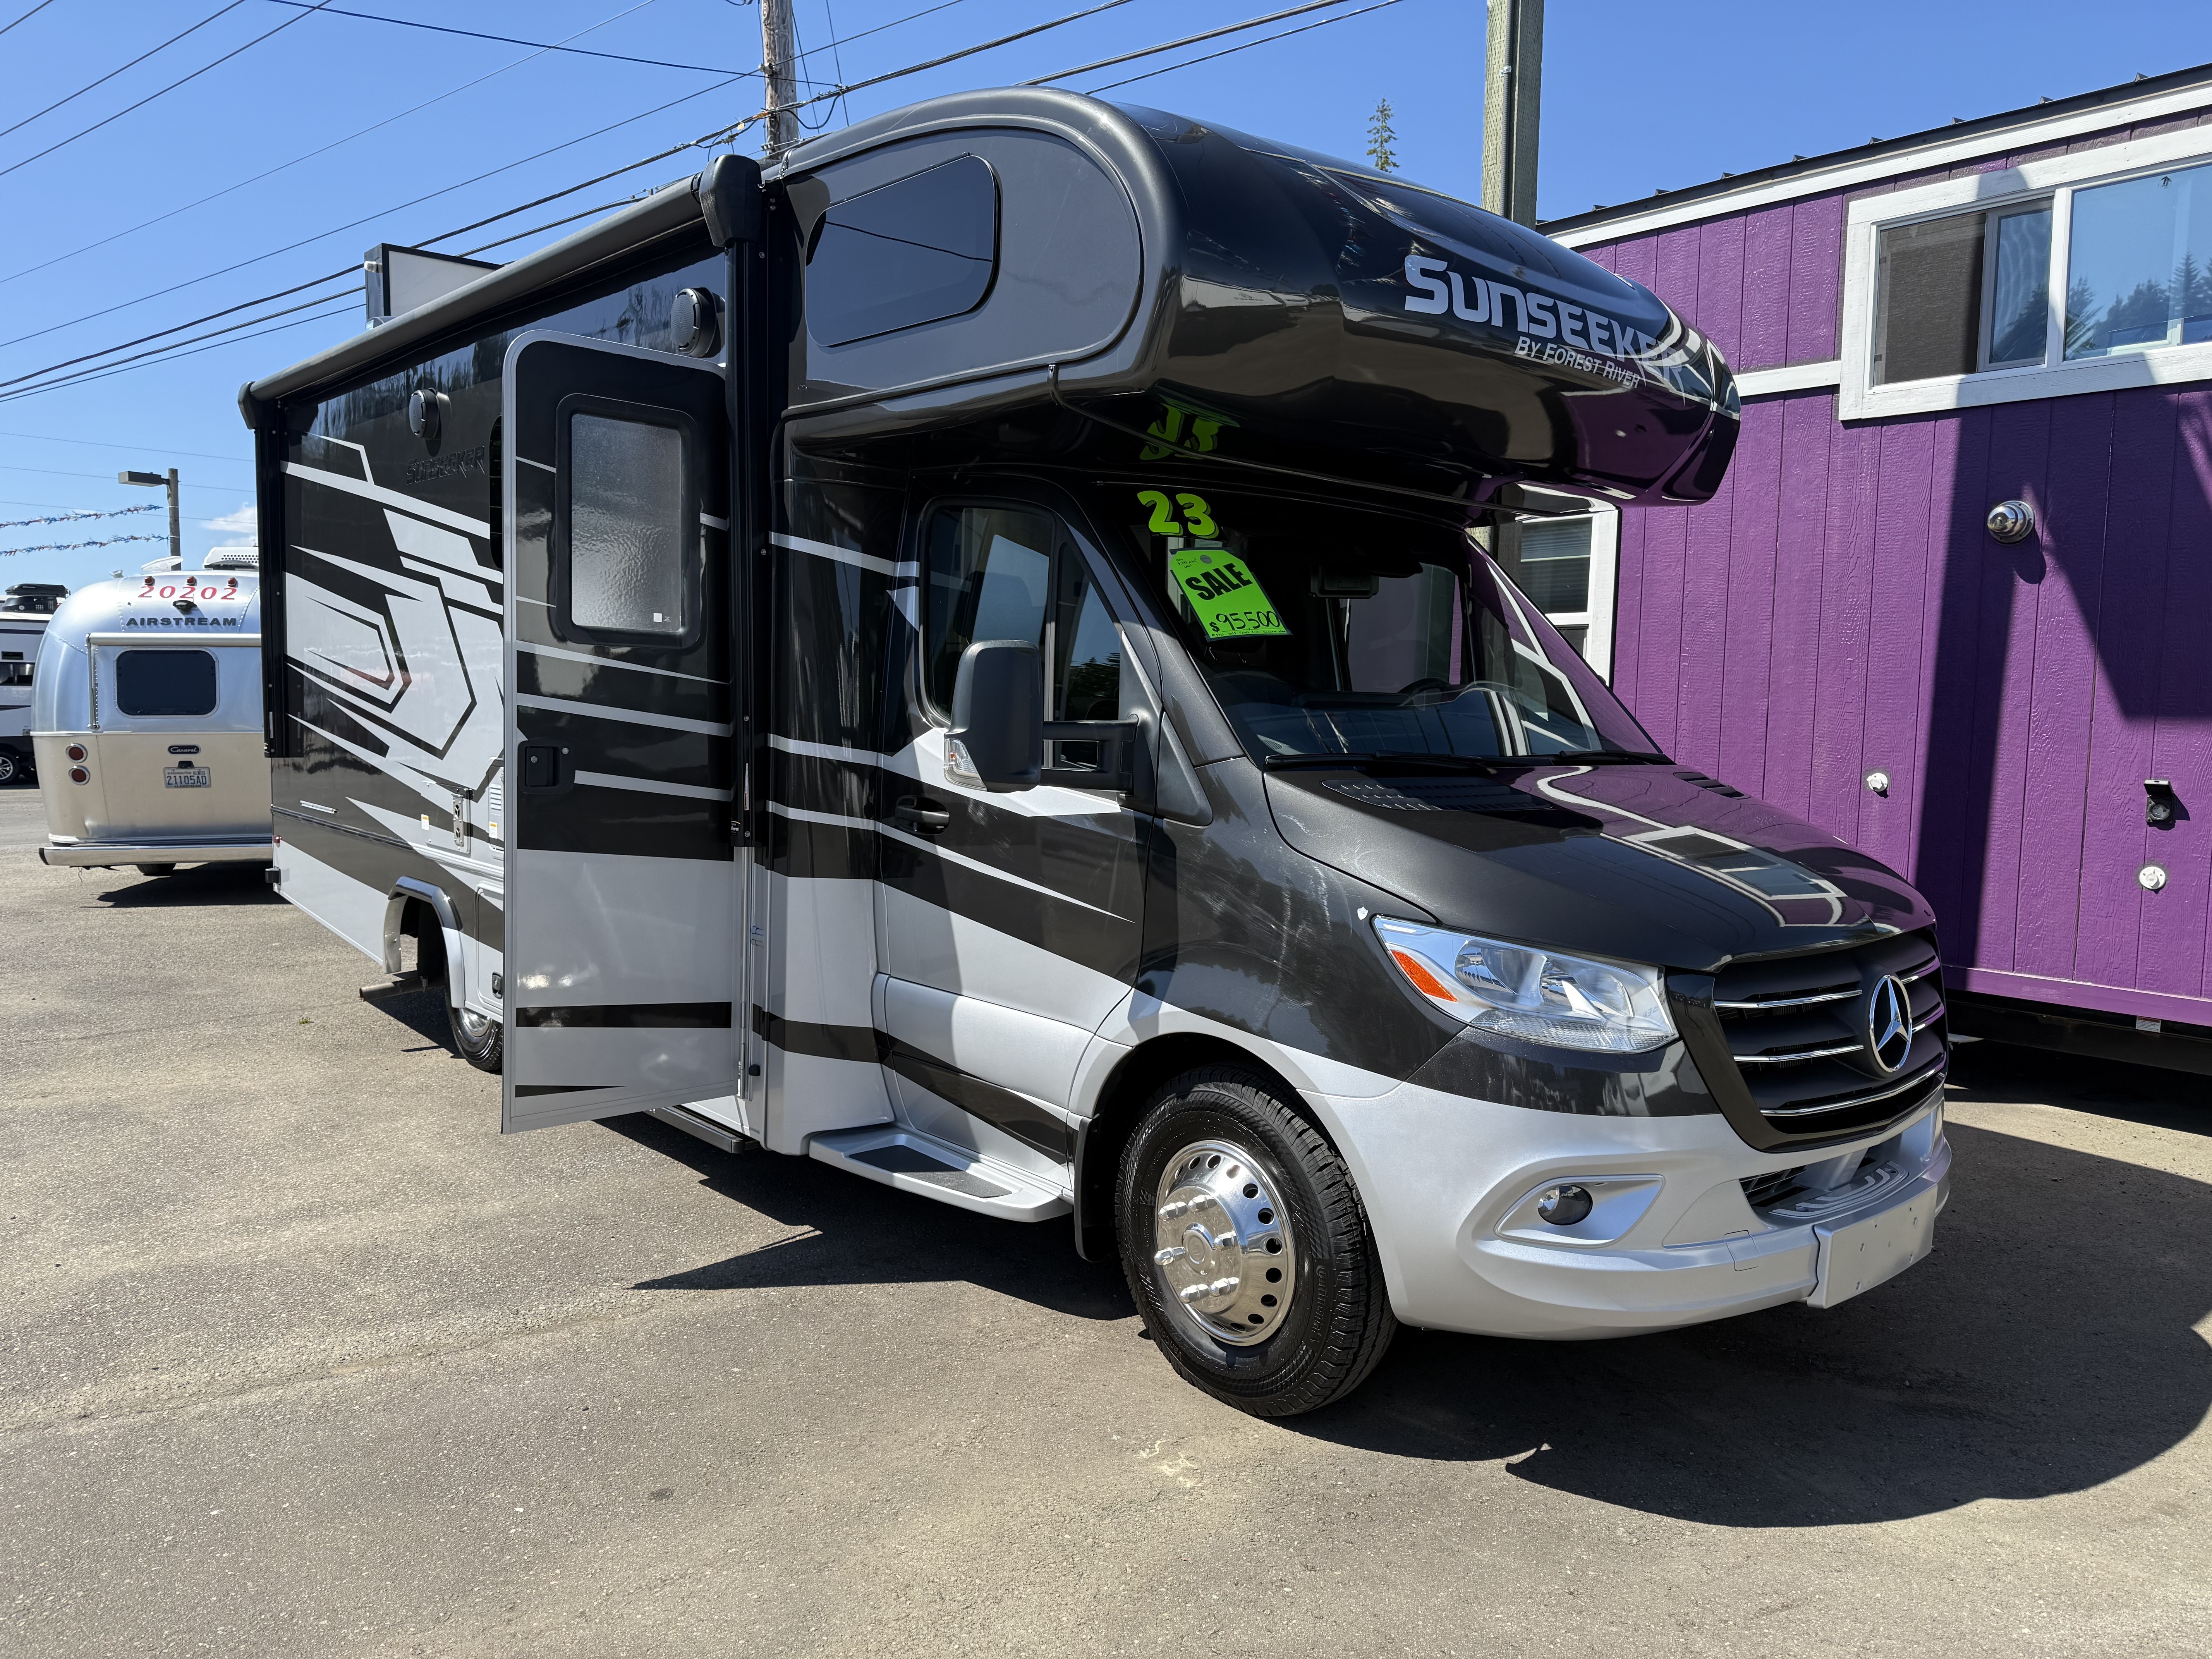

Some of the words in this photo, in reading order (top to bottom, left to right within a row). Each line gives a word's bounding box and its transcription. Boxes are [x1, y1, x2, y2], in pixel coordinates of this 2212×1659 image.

[1514, 336, 1542, 357] BY
[1542, 343, 1602, 374] FOREST
[1602, 361, 1640, 388] RIVER
[1137, 490, 1219, 539] 23
[138, 586, 237, 600] 20202
[1185, 562, 1253, 601] SALE
[126, 617, 236, 626] AIRSTREAM
[167, 775, 207, 785] 21105AD
